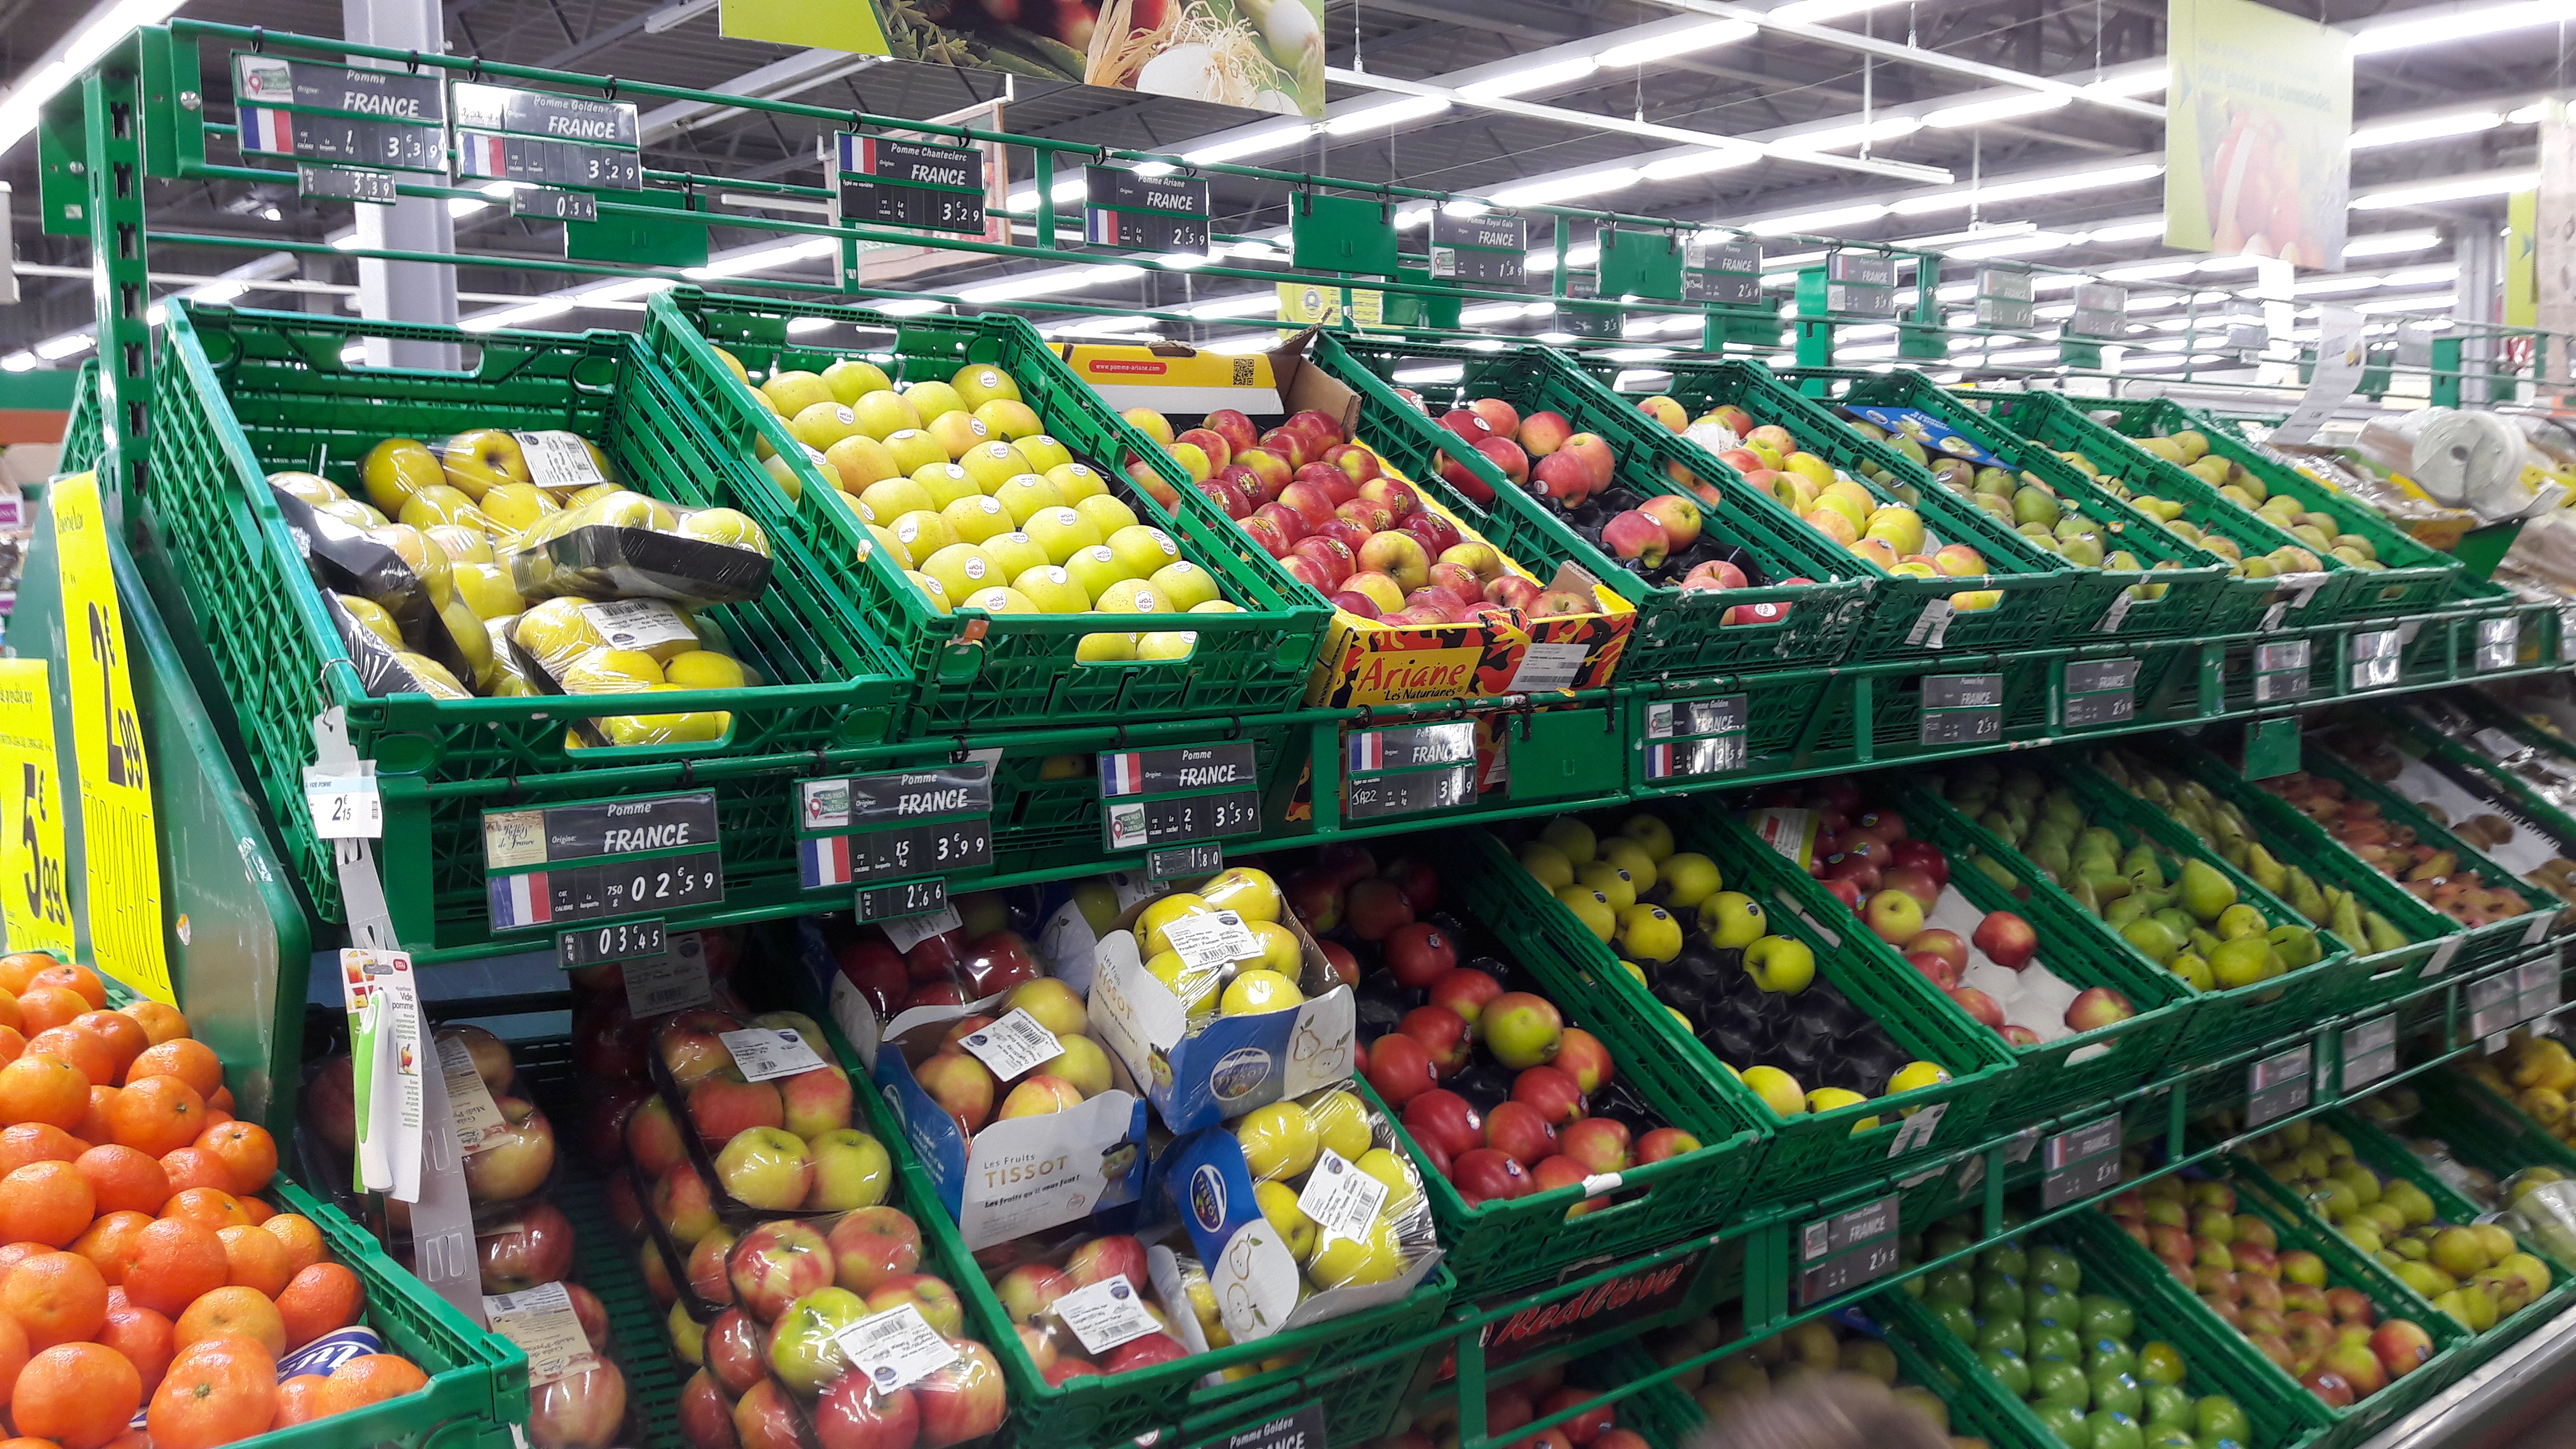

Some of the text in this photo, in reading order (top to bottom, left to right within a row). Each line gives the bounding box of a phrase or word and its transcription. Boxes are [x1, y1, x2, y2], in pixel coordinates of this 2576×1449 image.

[346, 69, 387, 84] Pomme
[343, 90, 420, 117] FRANCE
[532, 94, 604, 113] Pomme Golden
[548, 115, 616, 140] FRANCE
[891, 142, 967, 162] Pomme Chanteclerc
[911, 164, 967, 185] FRANCE
[1138, 175, 1185, 188] Pomme Ariane
[1147, 191, 1194, 210] FRANCE
[1486, 218, 1501, 228] Royal
[1478, 230, 1515, 246] FRANCE
[1722, 257, 1752, 272] FRANCE
[1095, 363, 1160, 373] www.pomme-ariane.com
[1357, 658, 1467, 691] Ariane
[1385, 688, 1401, 701] Les
[1695, 715, 1734, 733] FRANCE
[1182, 749, 1212, 761] Pomme
[900, 774, 938, 786] Pomme
[1179, 764, 1236, 787] FRANCE
[607, 803, 652, 817] Pomme
[897, 788, 968, 816] FRANCE
[552, 834, 577, 844] Origine:
[603, 822, 690, 853] FRANCE
[83, 793, 168, 991] ESPAGNE
[607, 884, 623, 895] 750
[400, 992, 412, 1001] Vide
[1098, 964, 1133, 1021] TISSOT
[1004, 1154, 1035, 1165] Fruits
[985, 1155, 1068, 1189] TISSOT
[999, 1193, 1022, 1207] fruits
[1229, 1417, 1294, 1449] Pomme Golden
